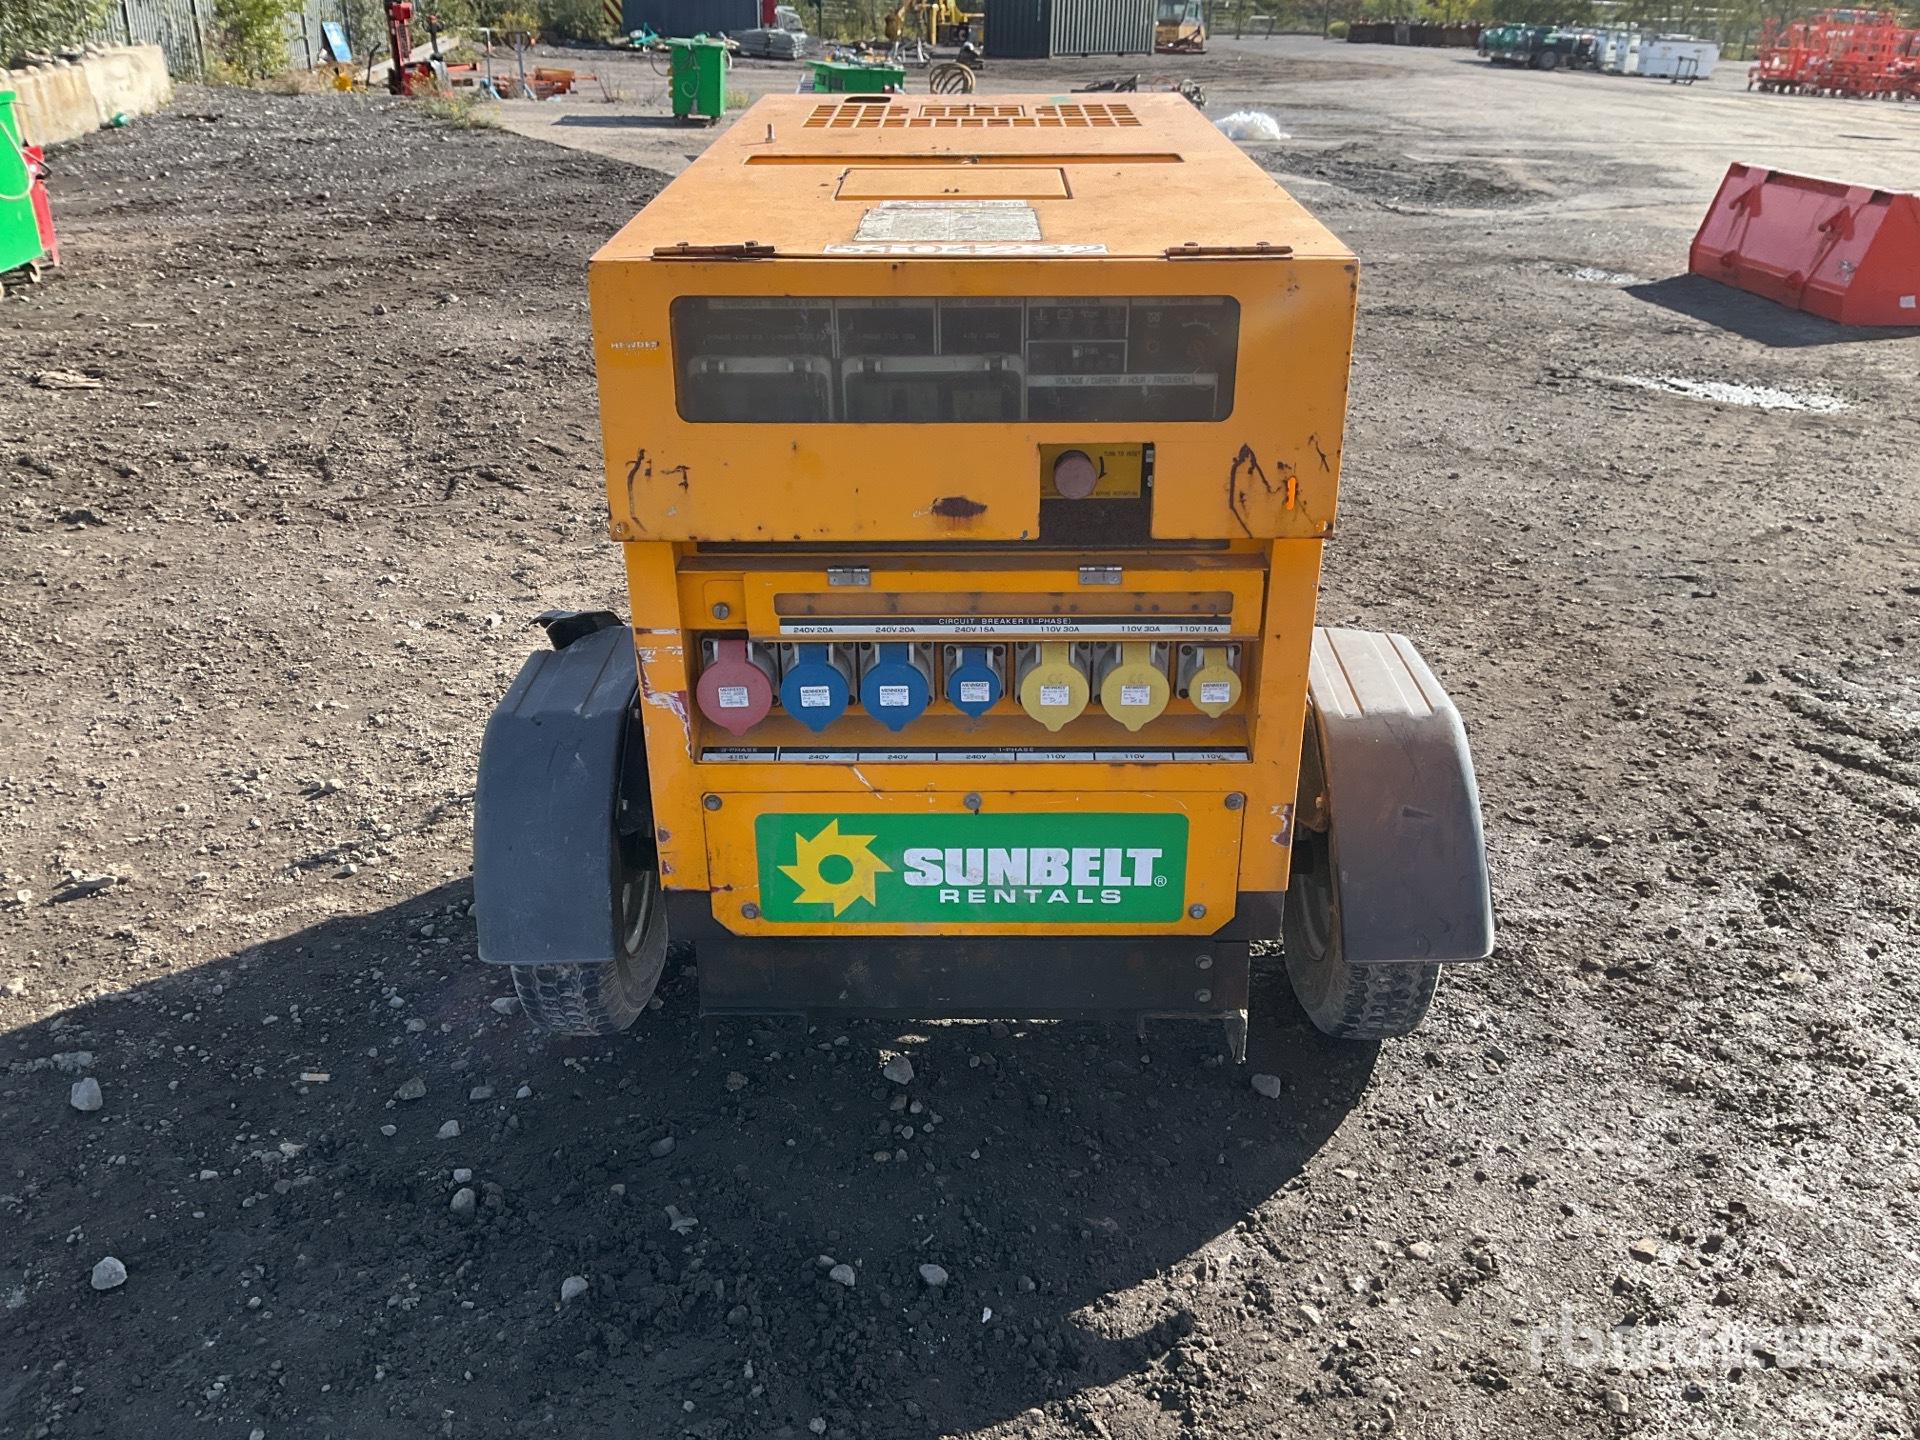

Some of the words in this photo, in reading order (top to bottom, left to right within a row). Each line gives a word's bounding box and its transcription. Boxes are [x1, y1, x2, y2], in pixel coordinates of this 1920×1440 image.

[1055, 376, 1084, 385] VOLTAGE
[1091, 376, 1121, 384] CURRENT
[1128, 375, 1146, 384] HOUR
[1153, 375, 1192, 384] FREQUENCY
[1027, 617, 1072, 625] (1-PHASE)
[903, 847, 1162, 886] SUNBELT
[939, 889, 1121, 904] RENTALS
